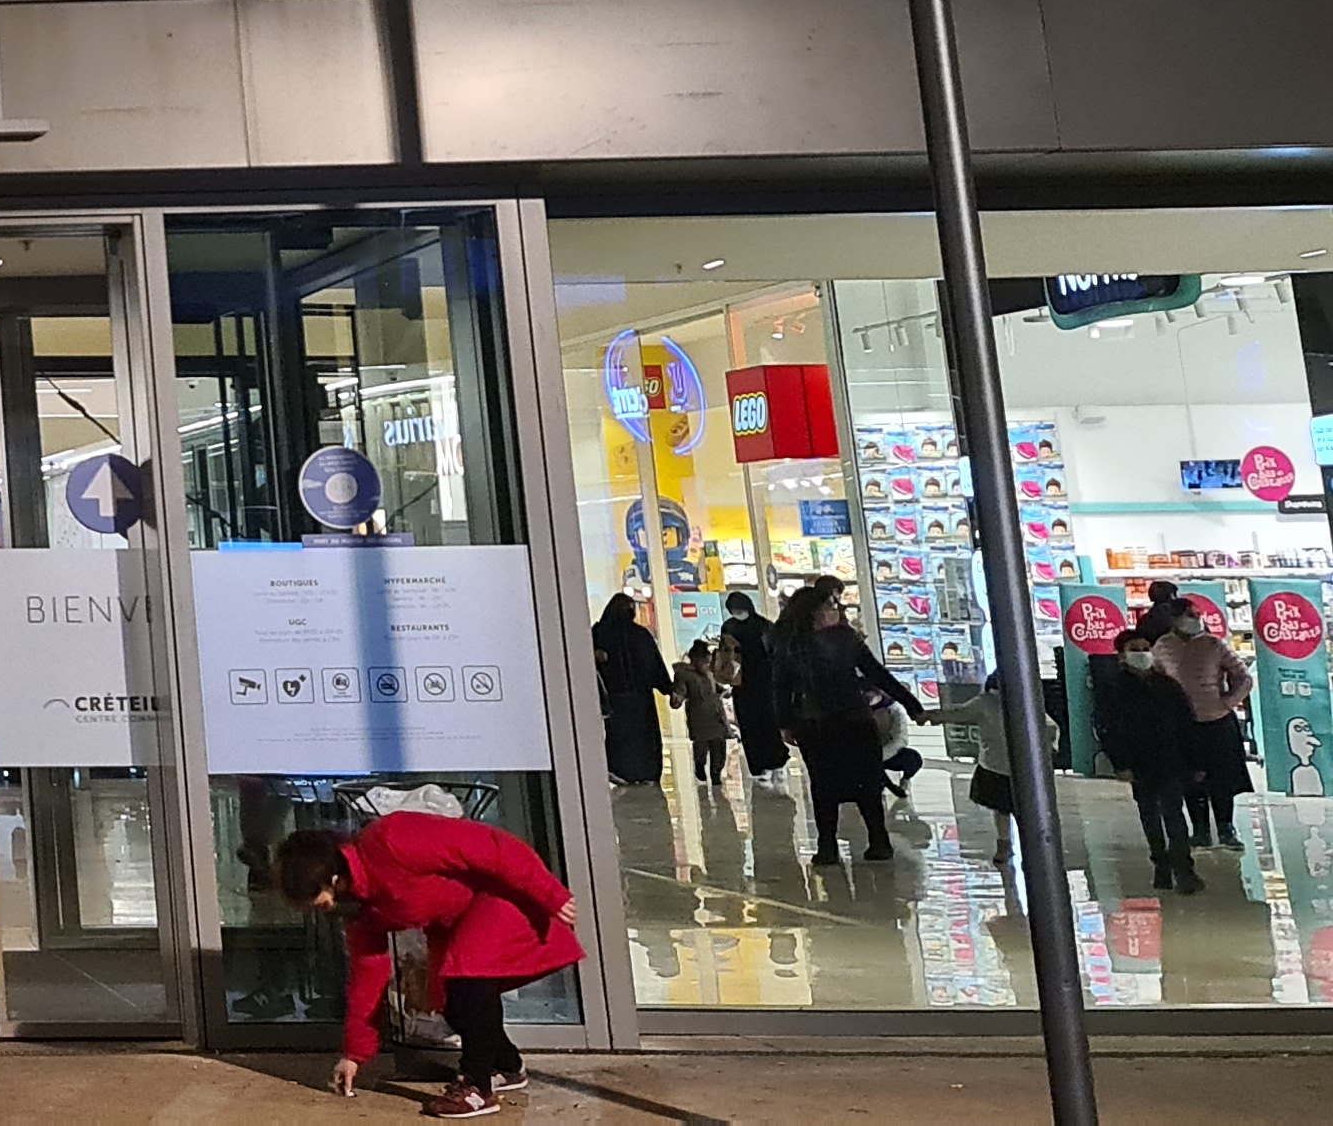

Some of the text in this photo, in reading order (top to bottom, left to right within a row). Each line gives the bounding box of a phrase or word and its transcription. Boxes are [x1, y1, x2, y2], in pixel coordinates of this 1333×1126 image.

[735, 392, 768, 433] LEGO
[1254, 454, 1277, 471] Prix
[270, 579, 319, 587] BOUTIQUES
[384, 576, 446, 585] HYPERMARCHÉ
[1081, 603, 1107, 621] Prix
[1274, 600, 1302, 620] Prix
[288, 618, 307, 626] UGC
[390, 624, 450, 632] RESTAURANTS
[1280, 617, 1299, 631] bas
[74, 692, 159, 712] CRÉTEIL
